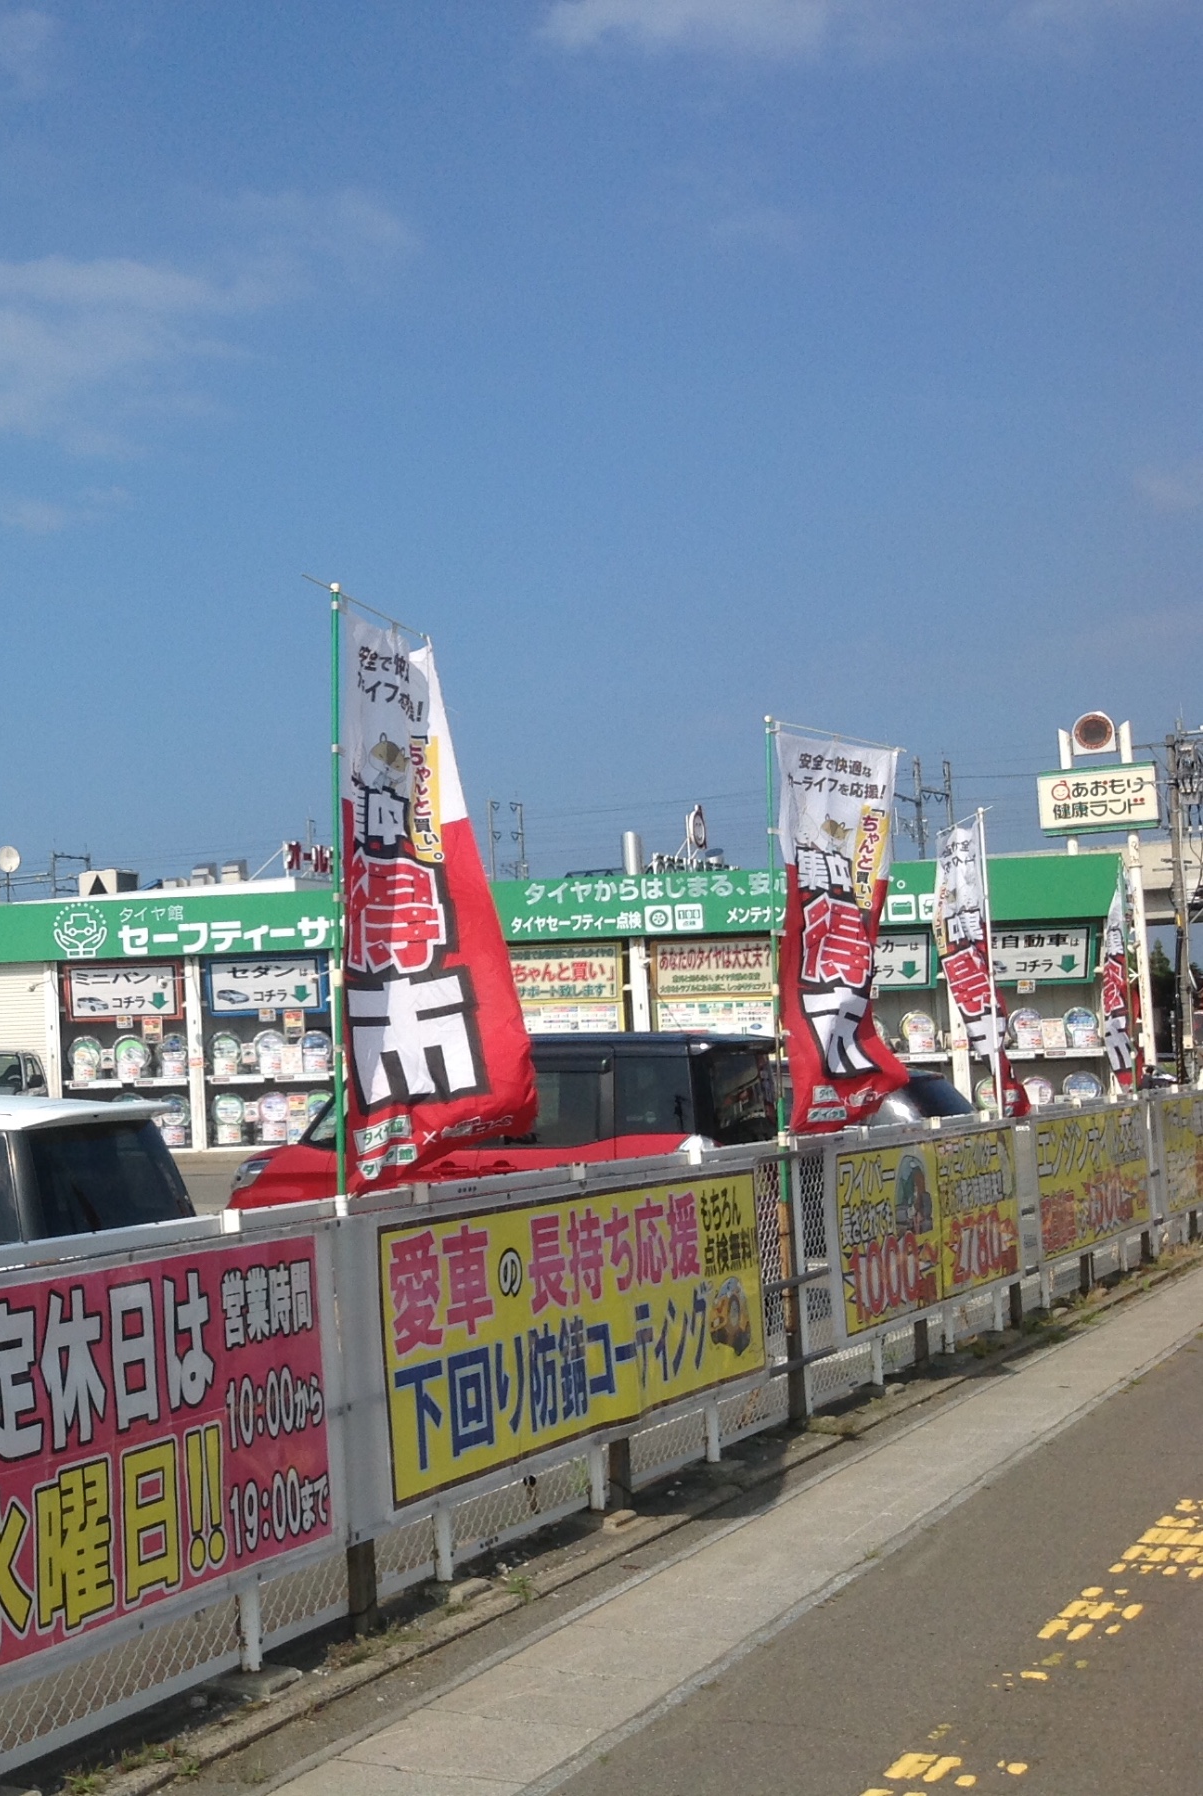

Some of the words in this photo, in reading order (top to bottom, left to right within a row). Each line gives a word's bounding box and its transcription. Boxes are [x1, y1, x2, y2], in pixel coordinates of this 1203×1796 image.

[799, 753, 872, 778] 安全で快適な
[1072, 777, 1144, 799] あおもり
[1052, 797, 1145, 820] 健康ランド
[119, 905, 184, 923] タイヤ館
[511, 911, 642, 933] タイヤセーフティー点検
[660, 944, 771, 971] あなたのタイヤは大丈夫?
[1015, 958, 1053, 973] コチラ
[111, 996, 146, 1010] コチラ
[253, 990, 288, 1003] コチラ
[839, 1155, 896, 1203] ワイパー
[700, 1186, 741, 1232] もちろん
[389, 1192, 700, 1355] 愛車の長持ち応援
[221, 1260, 314, 1350] 営業時間
[394, 1278, 712, 1472] 下回り防錆コーティング
[226, 1365, 324, 1451] 10:00から
[229, 1466, 330, 1558] 19:00まで
